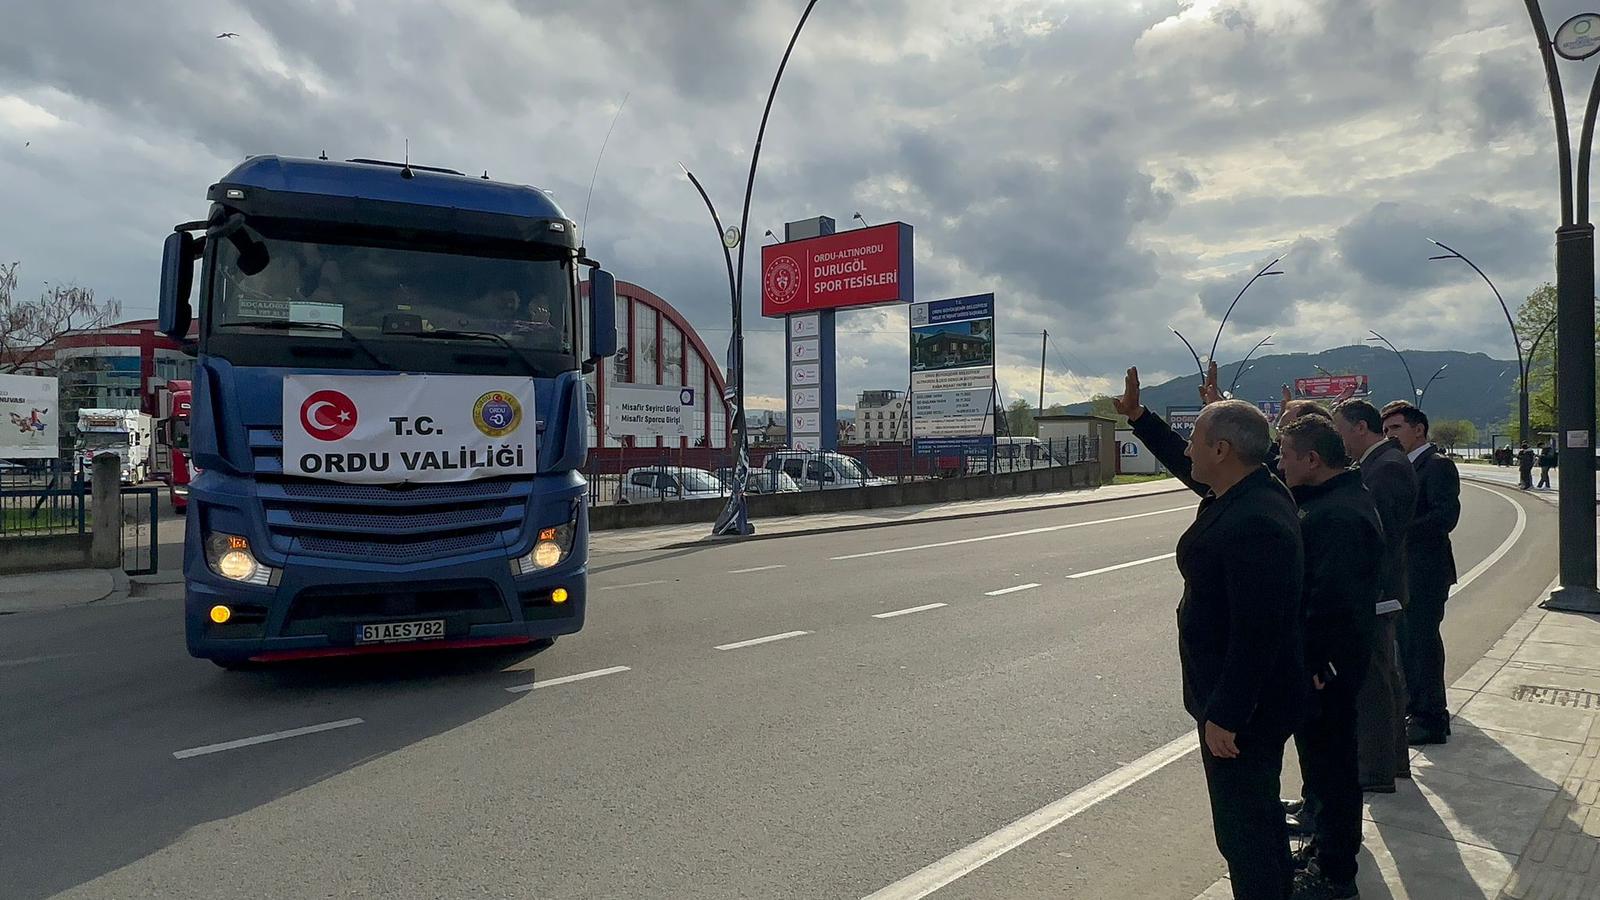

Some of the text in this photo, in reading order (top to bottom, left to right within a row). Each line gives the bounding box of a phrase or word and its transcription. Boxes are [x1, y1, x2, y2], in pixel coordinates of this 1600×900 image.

[814, 244, 883, 263] ORDU-ALTINORDU
[814, 259, 868, 278] DURUGÖL
[814, 269, 898, 294] SPOR TESİSLERİ
[622, 403, 681, 414] Misafir Seyirci Girişi
[389, 416, 443, 436] T.C.
[645, 415, 665, 424] Sporcu
[666, 416, 681, 425] Girişi
[300, 444, 524, 474] ORDU VALİLİĞİ
[364, 626, 379, 639] 61
[383, 624, 412, 638] AES
[414, 622, 442, 636] 782
